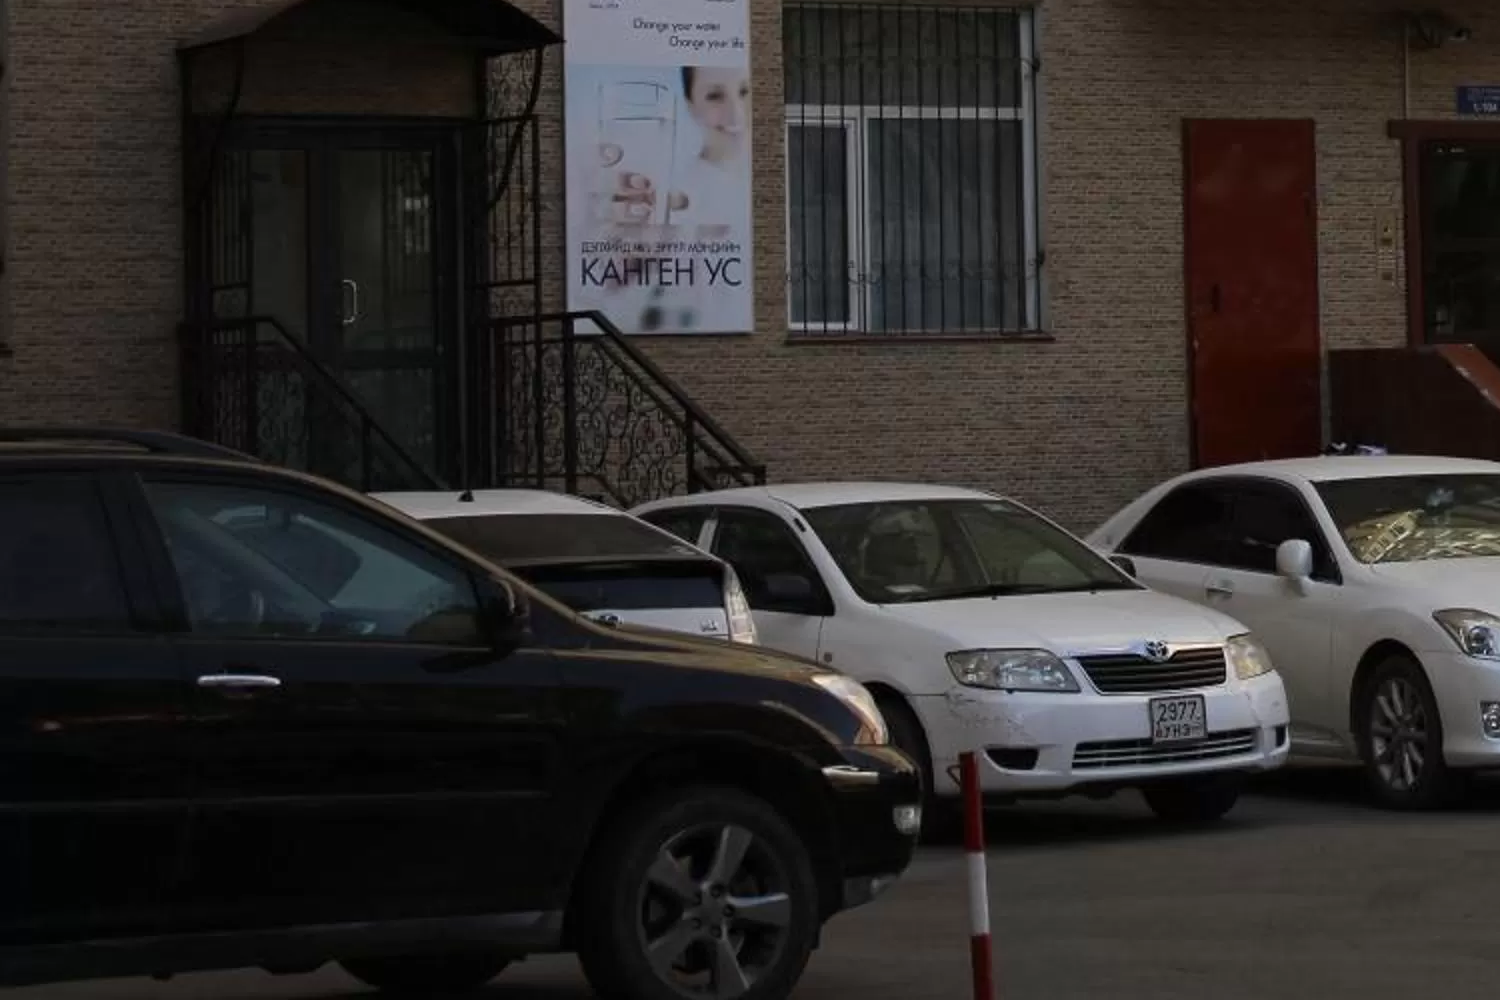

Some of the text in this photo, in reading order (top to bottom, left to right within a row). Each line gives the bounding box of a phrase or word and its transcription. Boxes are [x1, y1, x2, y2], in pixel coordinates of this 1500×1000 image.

[581, 257, 742, 287] КАНГЕН УС
[1158, 701, 1197, 722] 2977
